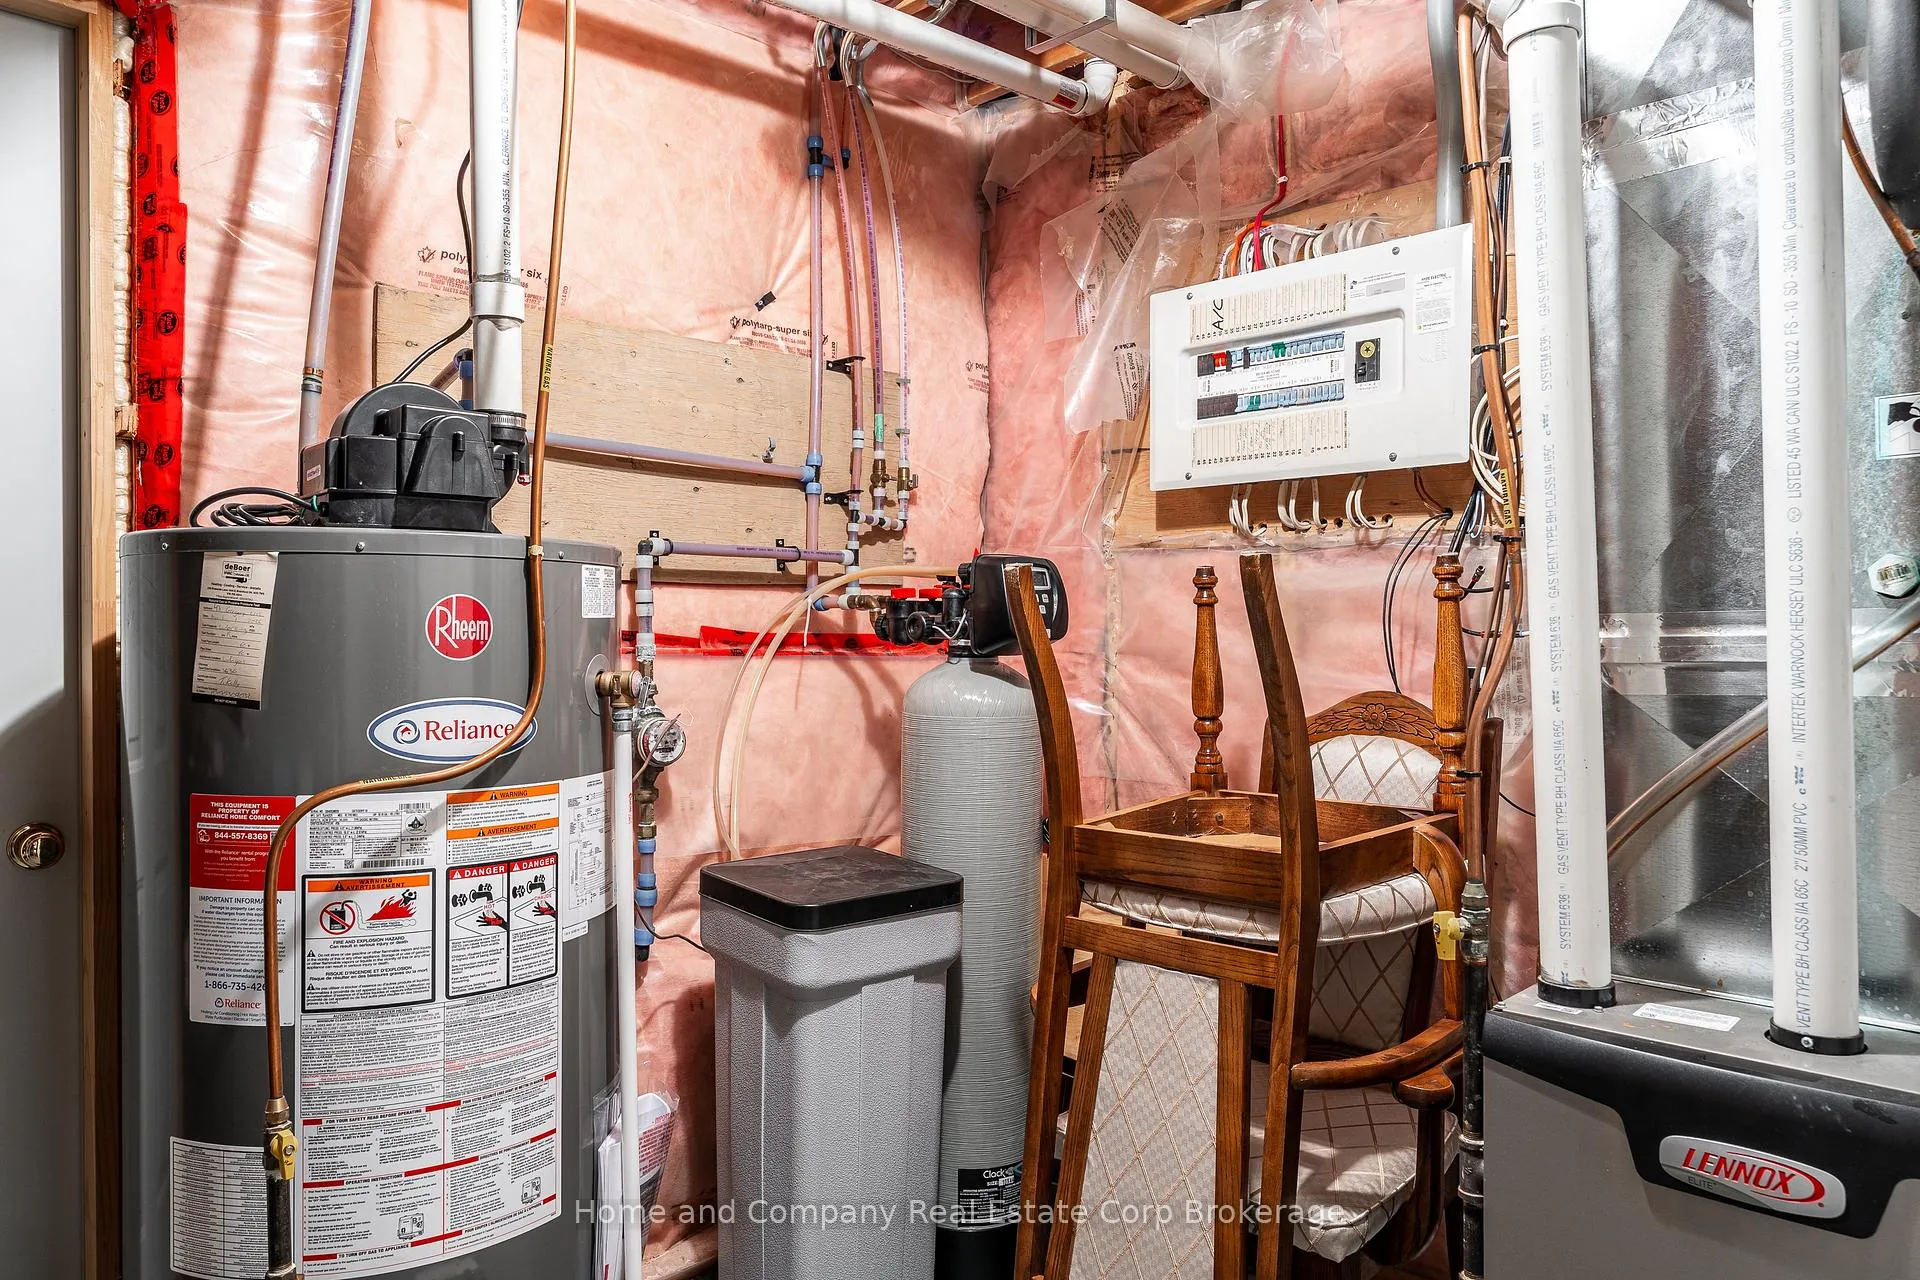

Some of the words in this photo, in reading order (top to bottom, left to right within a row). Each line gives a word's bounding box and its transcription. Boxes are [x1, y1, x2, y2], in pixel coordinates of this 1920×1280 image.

[527, 269, 542, 280] six
[1212, 299, 1224, 330] A/C
[742, 318, 800, 335] polytarp-super
[1540, 335, 1551, 352] 636
[544, 346, 553, 374] NATURAL
[1784, 340, 1799, 374] S102.2
[1540, 353, 1552, 392] SYSTEM
[1786, 375, 1800, 398] ULC
[1786, 427, 1800, 446] WA
[1786, 447, 1801, 460] 45
[1500, 472, 1509, 504] NATURAL
[1787, 462, 1802, 499] LISTED
[1504, 506, 1512, 525] GAS
[224, 563, 251, 572] deBoer
[1789, 564, 1804, 586] ULC
[1789, 588, 1805, 632] HERSEY
[434, 595, 489, 649] Rheem
[1549, 616, 1561, 632] 636
[1550, 633, 1562, 672] SYSTEM
[1790, 634, 1806, 690] WARNOCK
[1791, 692, 1806, 743] INTERTEK
[424, 719, 513, 741] Reliance
[499, 790, 528, 798] WARNING
[1793, 802, 1807, 825] PVC
[214, 832, 268, 840] 844-557-8369
[487, 824, 537, 835] AVERTISSEMENT
[464, 865, 505, 877] DANGER
[522, 857, 555, 869] DANGER
[346, 882, 405, 890] AVERTISSEMENT
[1794, 880, 1808, 900] 65C
[1558, 893, 1570, 910] 636
[1794, 901, 1809, 915] IIA
[1559, 912, 1572, 950] SYSTEM
[1794, 917, 1810, 951] CLASS
[1795, 954, 1810, 970] BH
[1796, 972, 1810, 1000] TYPE
[224, 998, 262, 1009] Reliance
[1796, 1001, 1811, 1029] VENT
[371, 1174, 403, 1183] INSTRUCTIONS
[1681, 1147, 1796, 1195] LENNOX
[1687, 1175, 1714, 1190] ELITE
[384, 1244, 409, 1252] APPLIANCE
